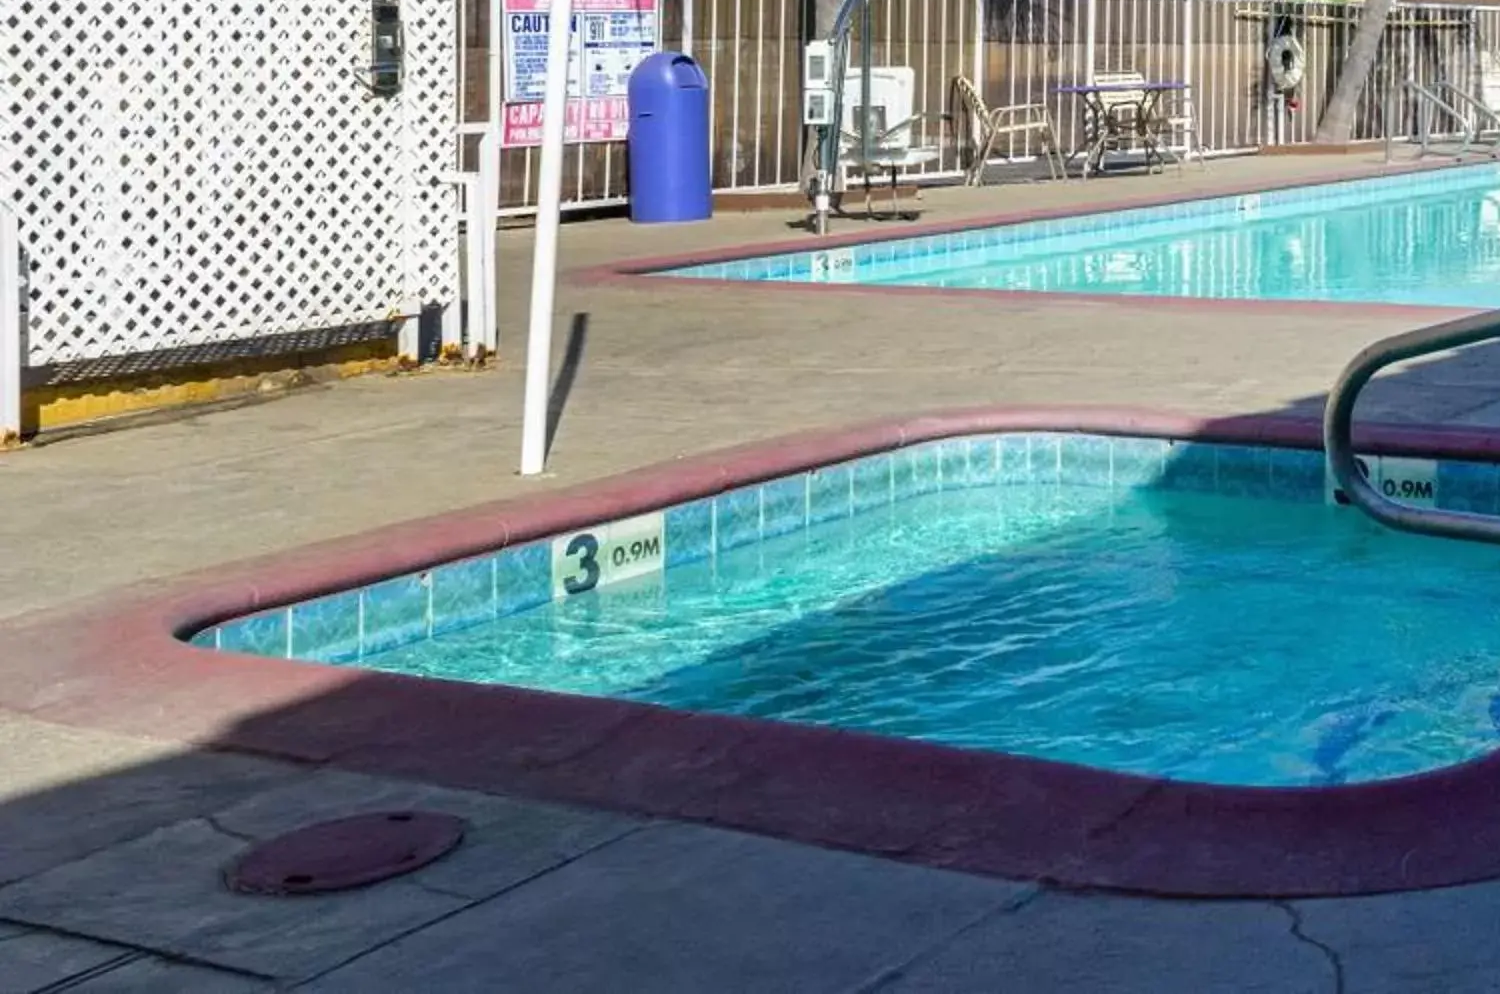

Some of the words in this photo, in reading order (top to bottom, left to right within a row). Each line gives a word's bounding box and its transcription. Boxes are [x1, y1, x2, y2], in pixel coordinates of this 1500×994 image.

[511, 15, 577, 33] CAUTN
[1383, 479, 1433, 498] 0.9M
[564, 533, 599, 594] 3
[613, 537, 660, 566] 0.9M
